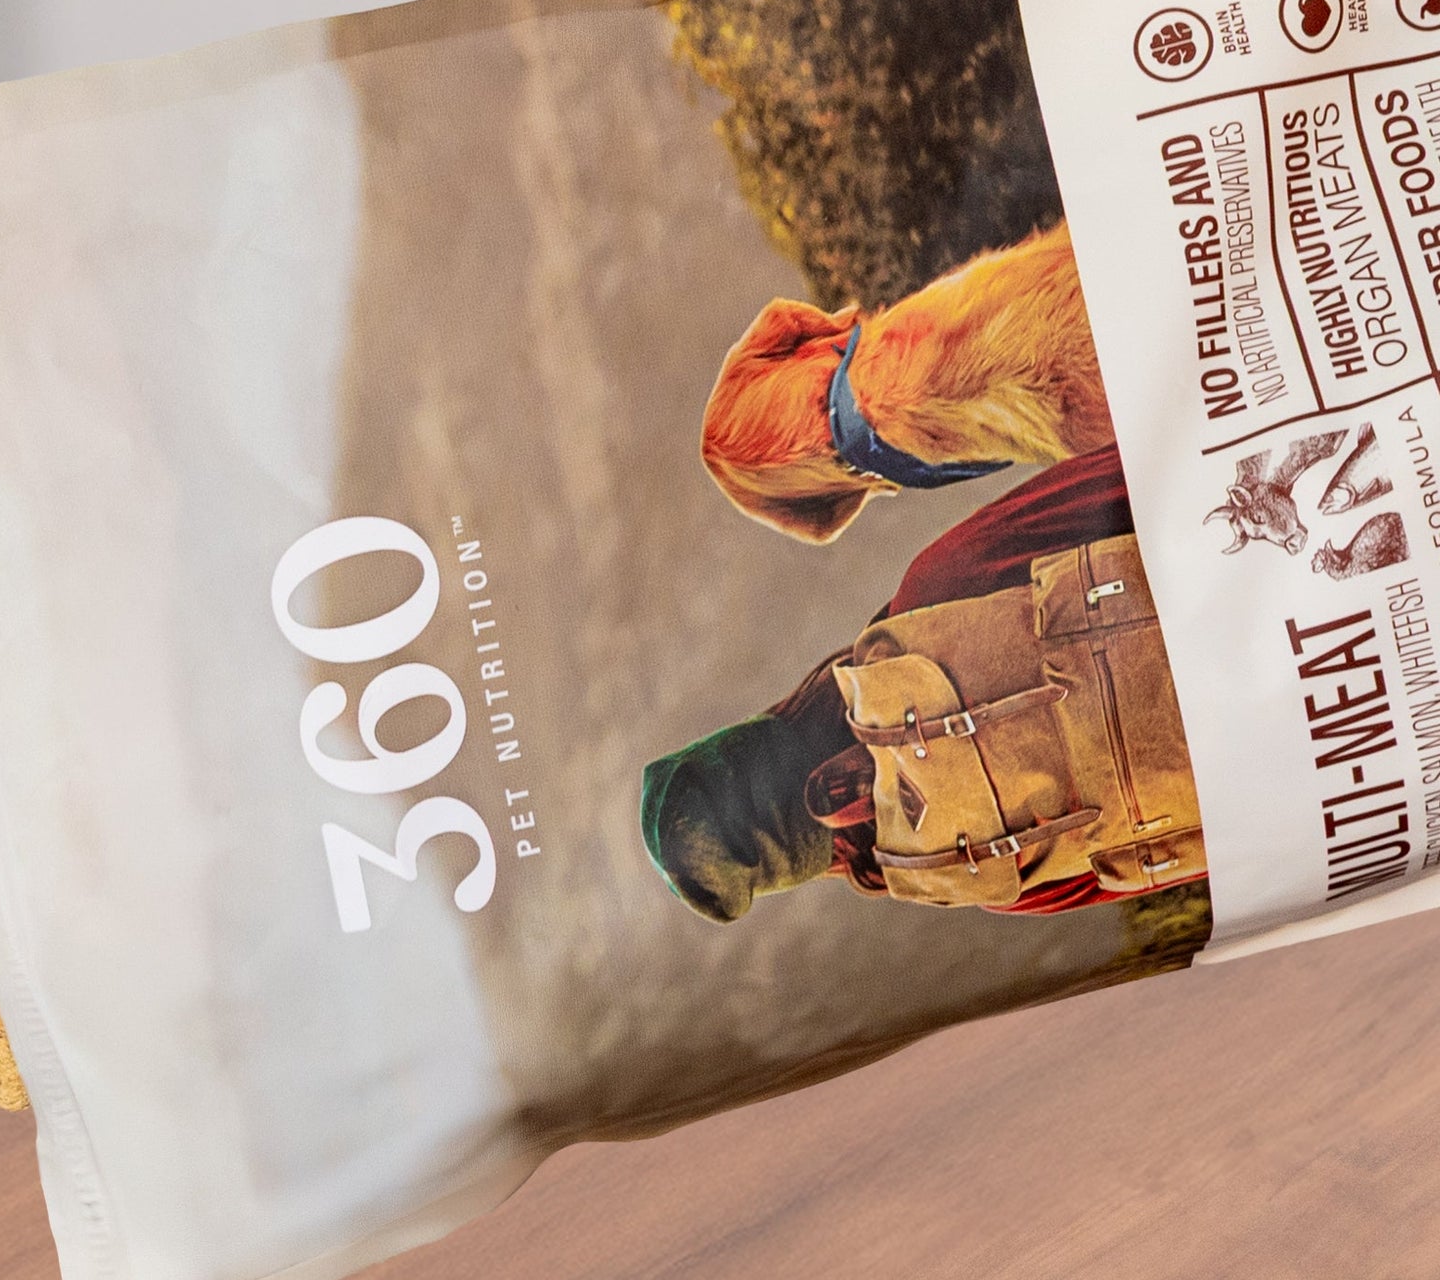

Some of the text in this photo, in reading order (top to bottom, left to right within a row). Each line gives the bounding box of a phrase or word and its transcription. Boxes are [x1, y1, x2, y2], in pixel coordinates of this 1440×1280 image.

[1216, 10, 1236, 54] BRAIN
[1229, 1, 1252, 56] HEALTH
[1374, 89, 1440, 217] FOODS
[1160, 133, 1248, 420] NO FILLERS AND
[1209, 121, 1289, 407] NO ARTIFICIAL PRESERVATIVES
[1283, 109, 1369, 380] HIGHLY NUTRITIOUS
[1313, 102, 1408, 367] ORGAN MEATS
[270, 515, 498, 934] 360
[1285, 608, 1411, 902] MULTI-MEAT
[1385, 578, 1439, 696] WHITEFISH
[505, 788, 541, 858] PET
